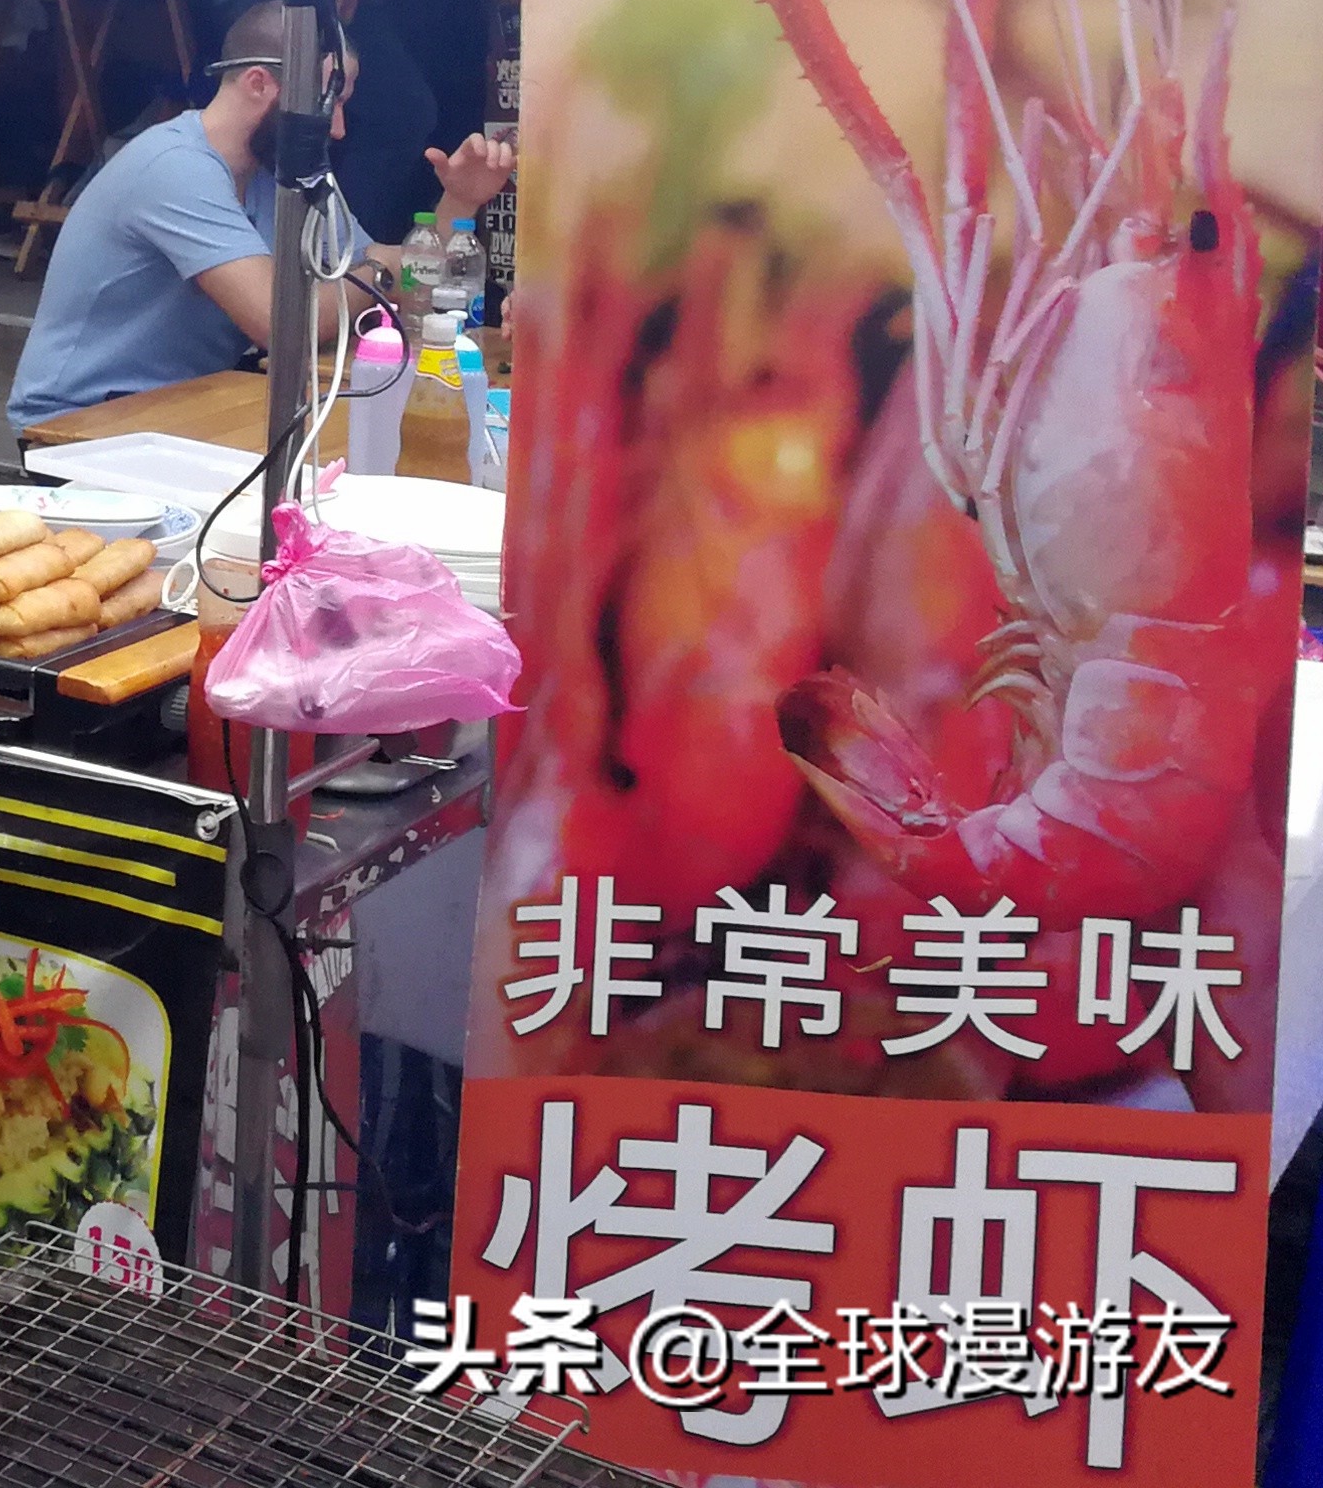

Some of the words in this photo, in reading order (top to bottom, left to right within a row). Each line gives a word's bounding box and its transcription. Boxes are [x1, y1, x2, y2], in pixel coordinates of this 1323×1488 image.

[504, 873, 1244, 1072] 非常美味
[470, 1100, 1239, 1471] 烤虾
